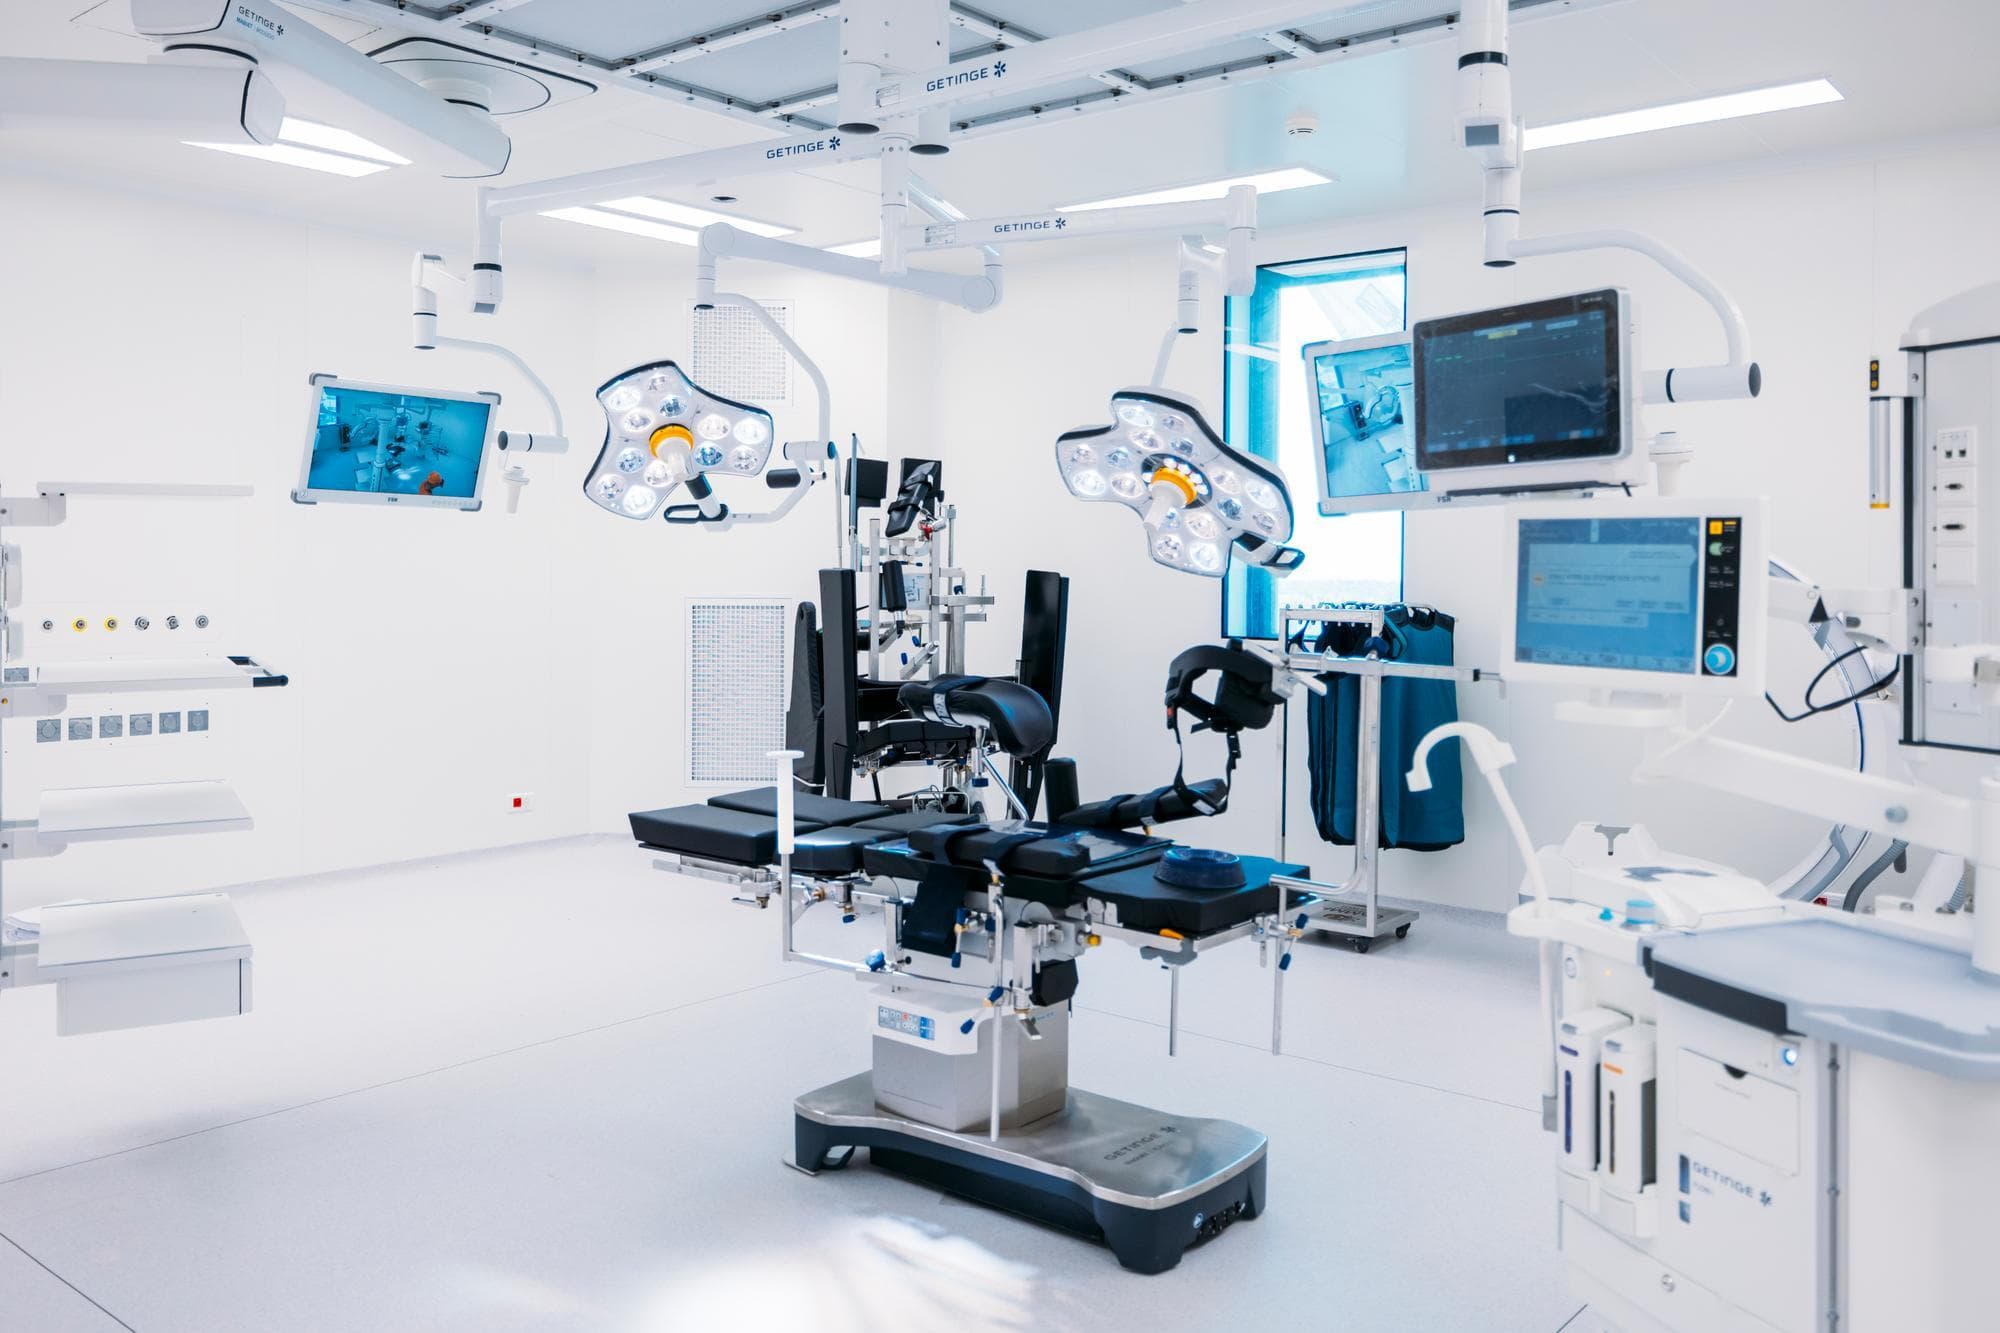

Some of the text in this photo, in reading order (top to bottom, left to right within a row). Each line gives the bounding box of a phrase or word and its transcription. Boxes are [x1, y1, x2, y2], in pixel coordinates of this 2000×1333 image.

[238, 5, 275, 31] GETINGE
[926, 67, 989, 92] GETINGE
[766, 140, 825, 159] GETINGE
[994, 220, 1051, 233] GETINGE
[1103, 1132, 1161, 1160] GETINGE
[1693, 1161, 1753, 1199] GETINGE
